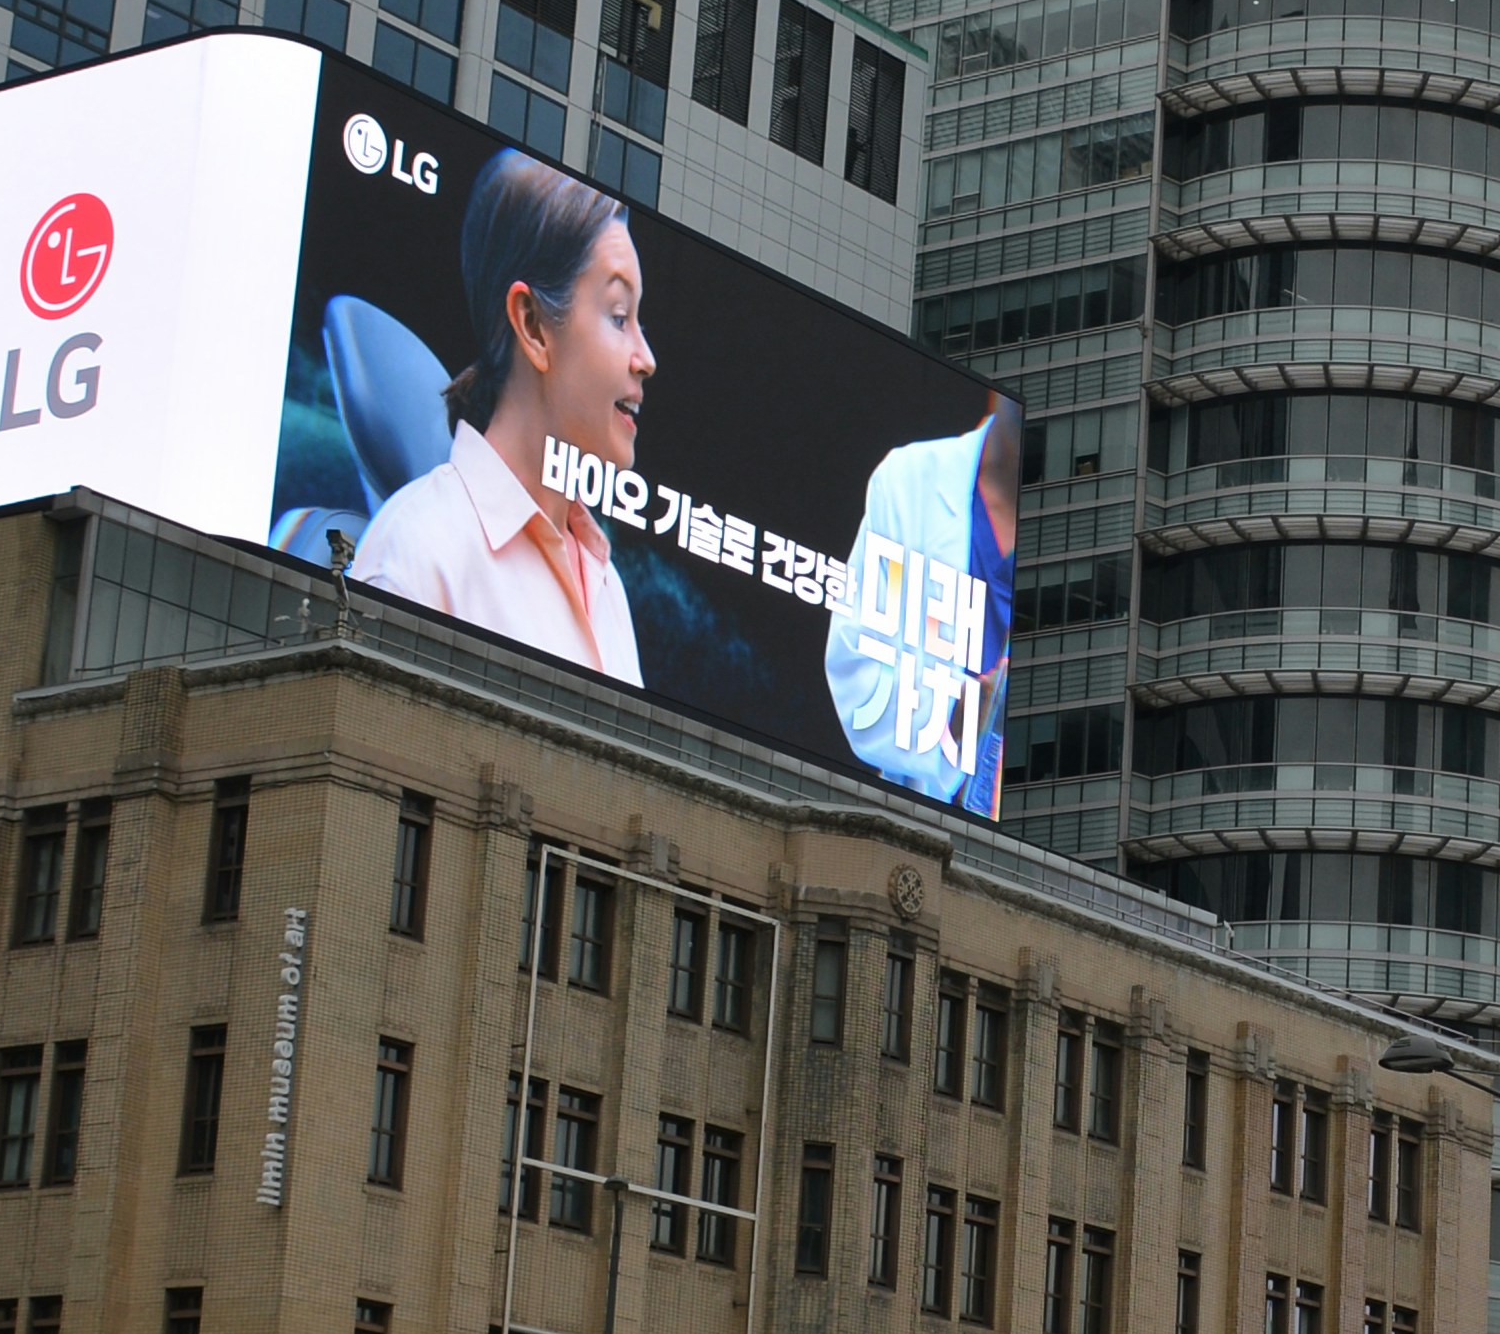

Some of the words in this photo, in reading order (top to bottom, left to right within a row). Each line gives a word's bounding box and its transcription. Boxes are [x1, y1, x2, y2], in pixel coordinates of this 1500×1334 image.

[391, 139, 440, 194] LG
[541, 435, 650, 531] 바이오
[654, 484, 756, 576] 기술로
[761, 529, 857, 618] 건강한
[861, 530, 987, 675] 미래
[852, 634, 981, 775] 가치
[278, 953, 302, 985] of
[284, 907, 307, 947] art
[268, 994, 299, 1123] museum
